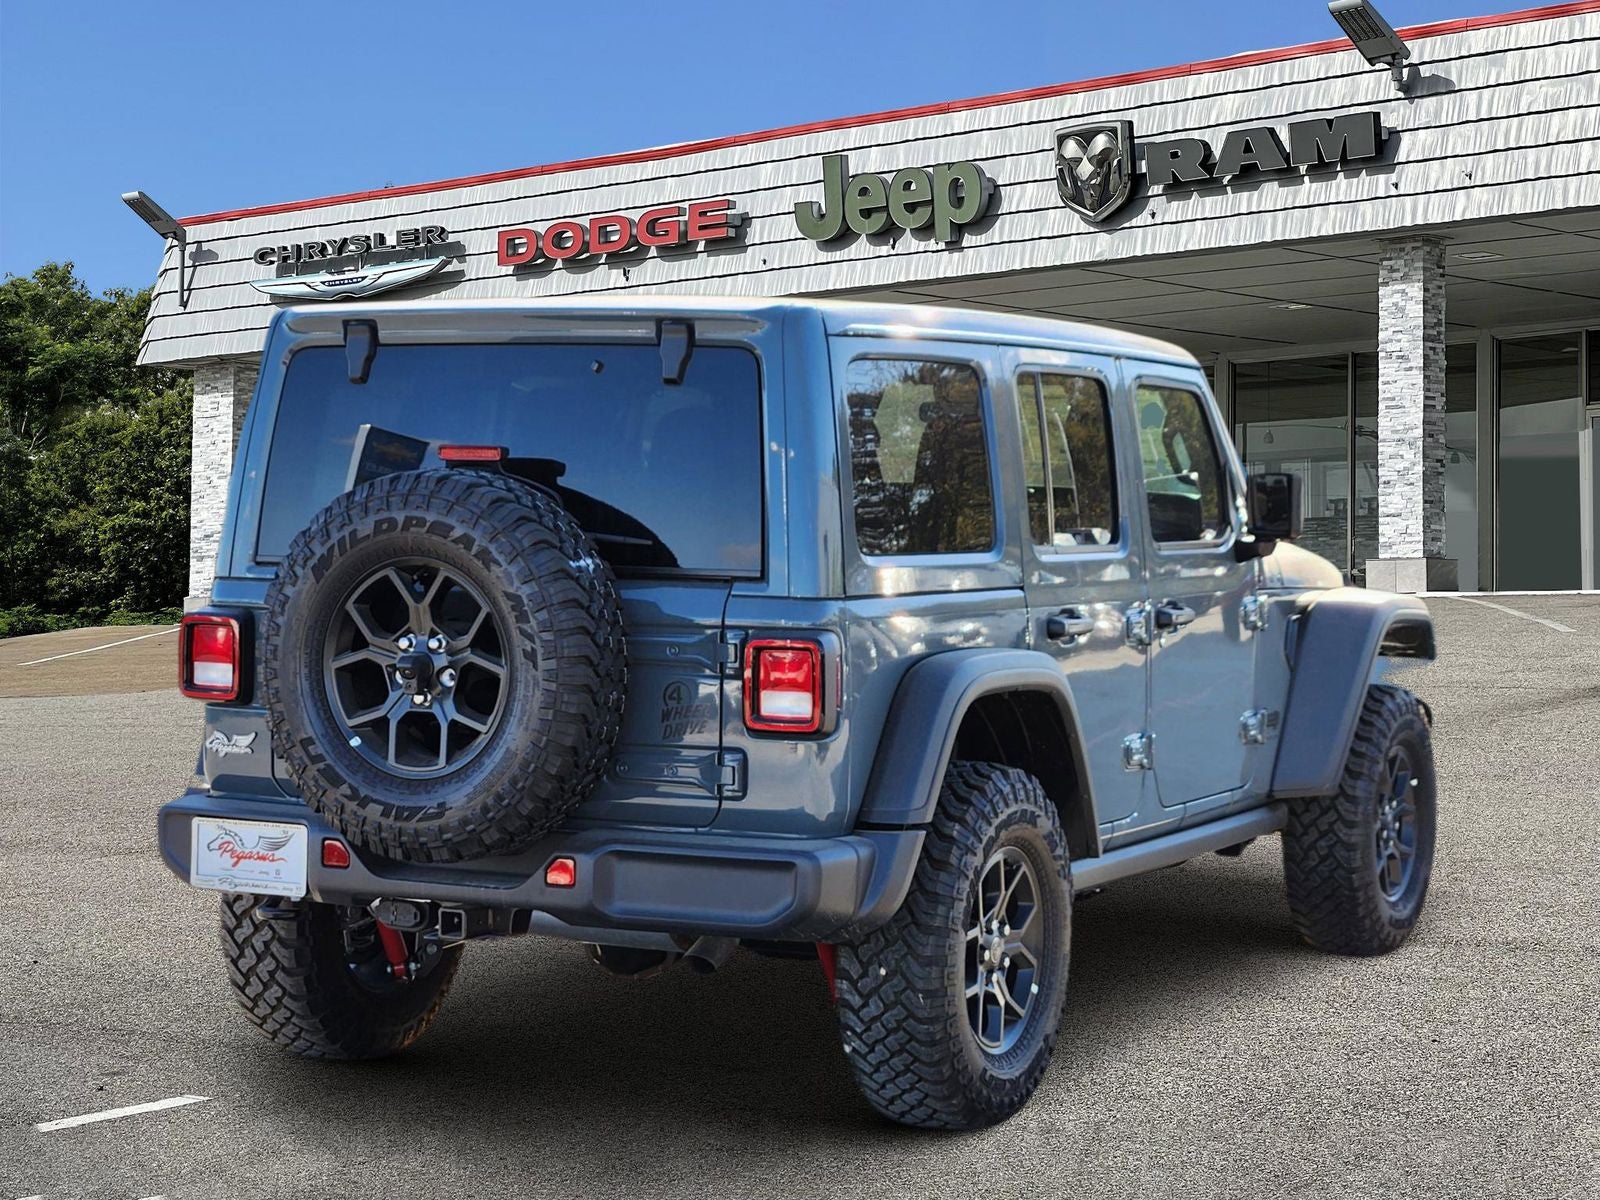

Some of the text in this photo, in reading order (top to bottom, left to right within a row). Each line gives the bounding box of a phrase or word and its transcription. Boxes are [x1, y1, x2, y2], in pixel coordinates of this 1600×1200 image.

[1145, 111, 1382, 186] RAM
[795, 154, 986, 242] Jeep
[253, 225, 449, 266] CHRYSLER
[498, 200, 736, 266] DODGE
[311, 516, 504, 585] WILDPEAK
[661, 704, 712, 723] WHEEL
[662, 720, 708, 741] DRIVE
[218, 840, 288, 868] Pegasus
